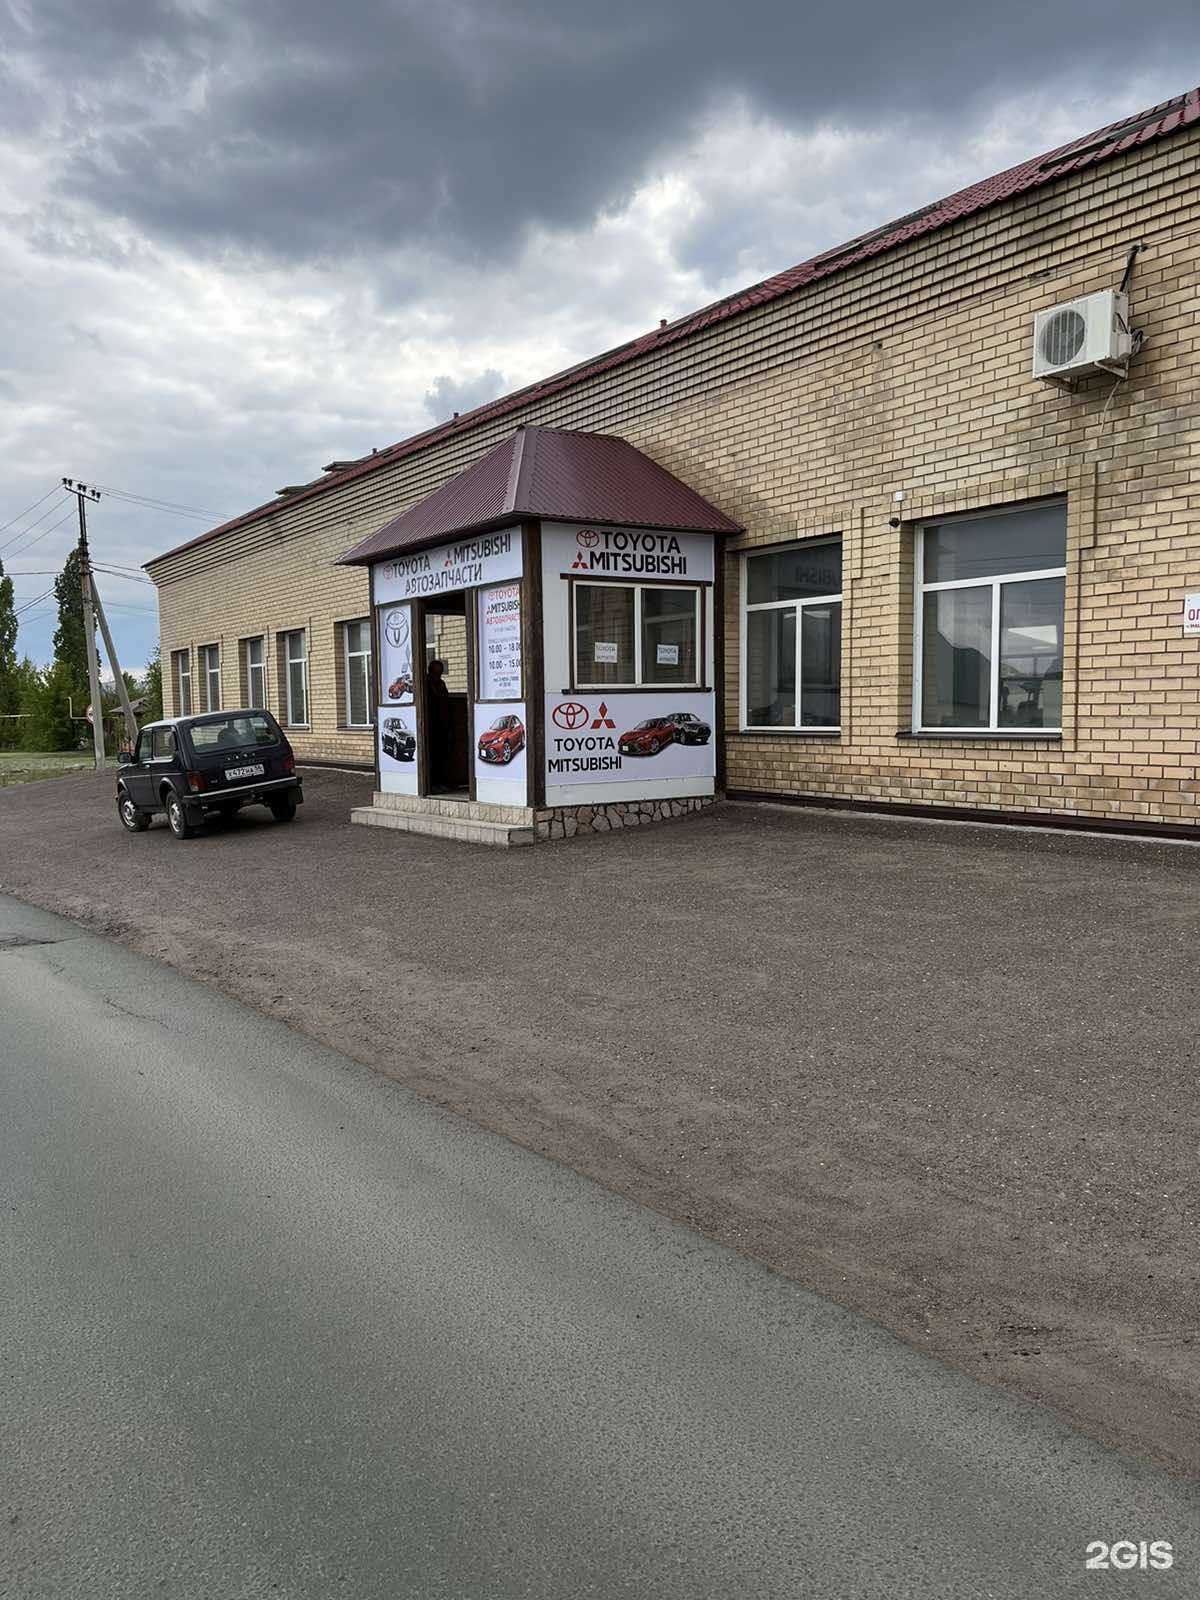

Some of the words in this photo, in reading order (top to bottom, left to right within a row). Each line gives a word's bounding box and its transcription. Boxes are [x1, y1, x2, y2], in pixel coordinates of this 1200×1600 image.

[601, 531, 681, 554] TOYOTA
[392, 555, 431, 578] TOYOTA
[454, 533, 511, 565] MITSUBISHI
[590, 551, 687, 575] MITSUBISHI
[405, 563, 482, 596] АВТОЗАПЧАСТИ
[554, 737, 615, 752] TOYOTA
[548, 756, 622, 773] MITSUBISHI
